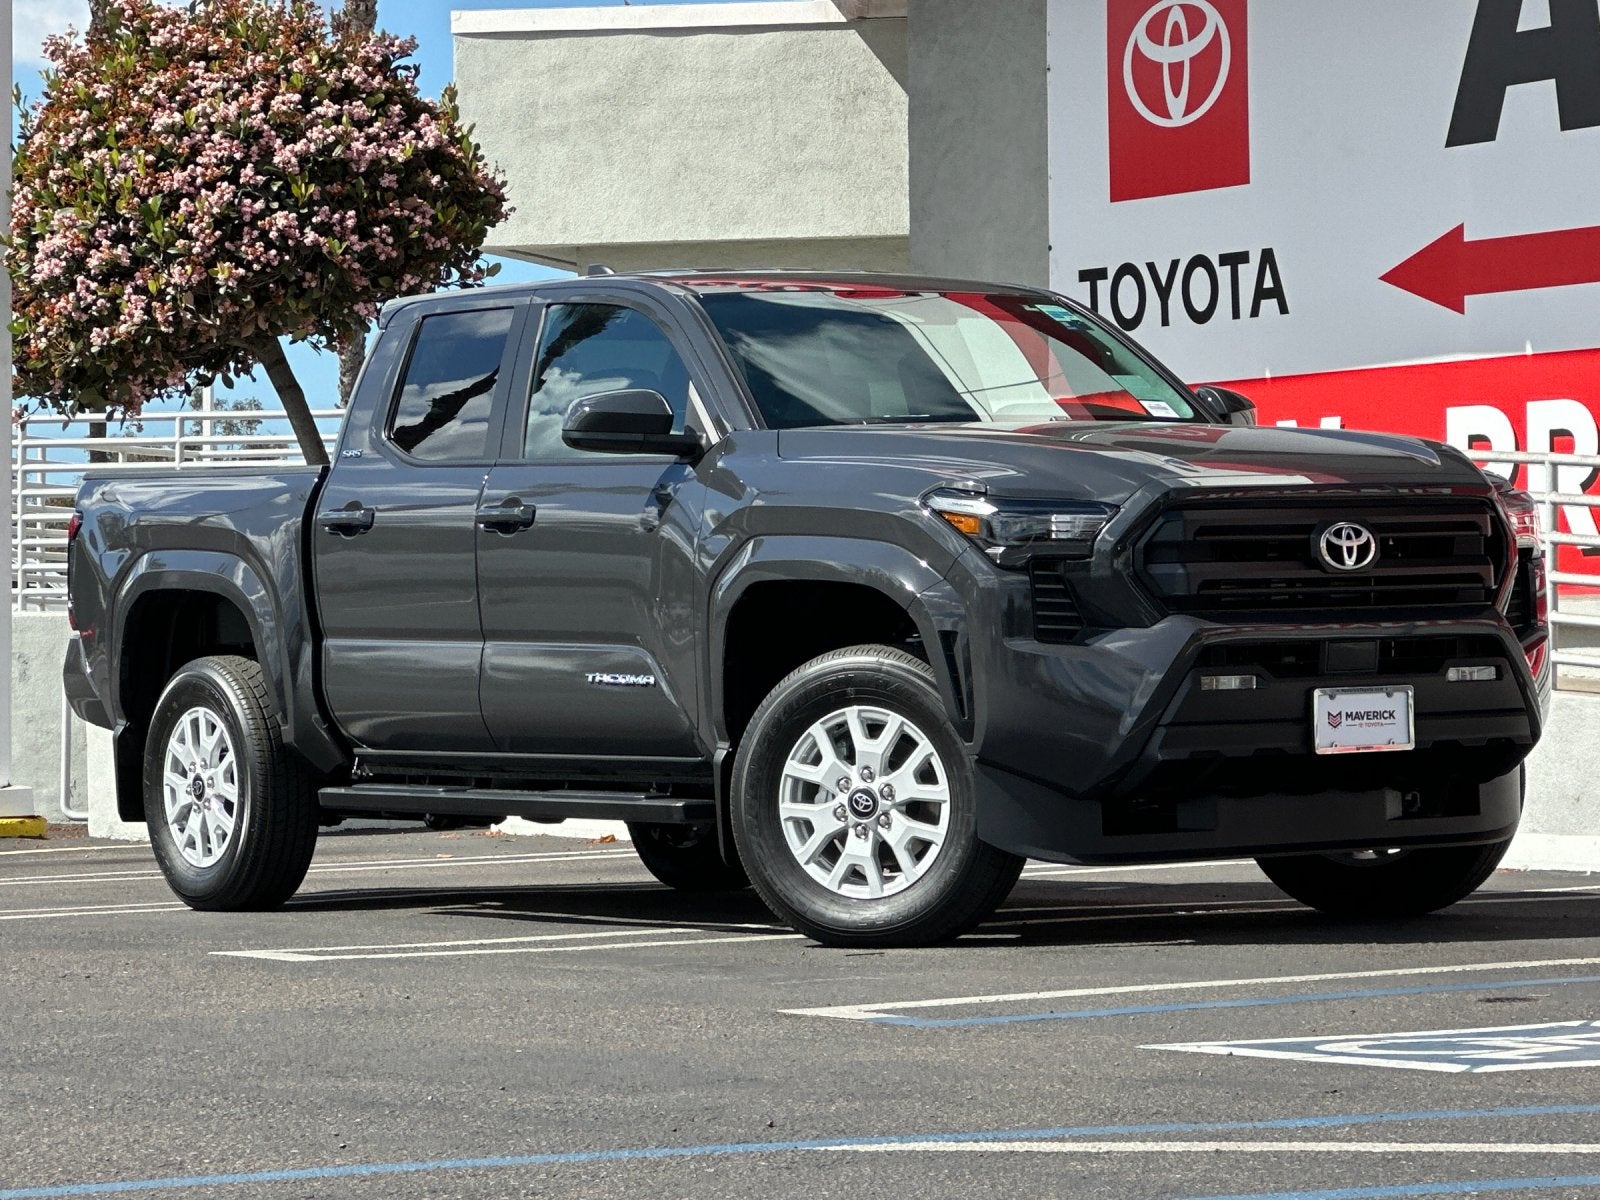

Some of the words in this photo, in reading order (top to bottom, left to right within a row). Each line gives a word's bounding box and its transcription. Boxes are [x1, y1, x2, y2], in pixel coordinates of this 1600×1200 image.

[1078, 248, 1289, 331] TOYOTA
[585, 672, 655, 686] TACOMA
[1345, 710, 1396, 721] MAVERICK
